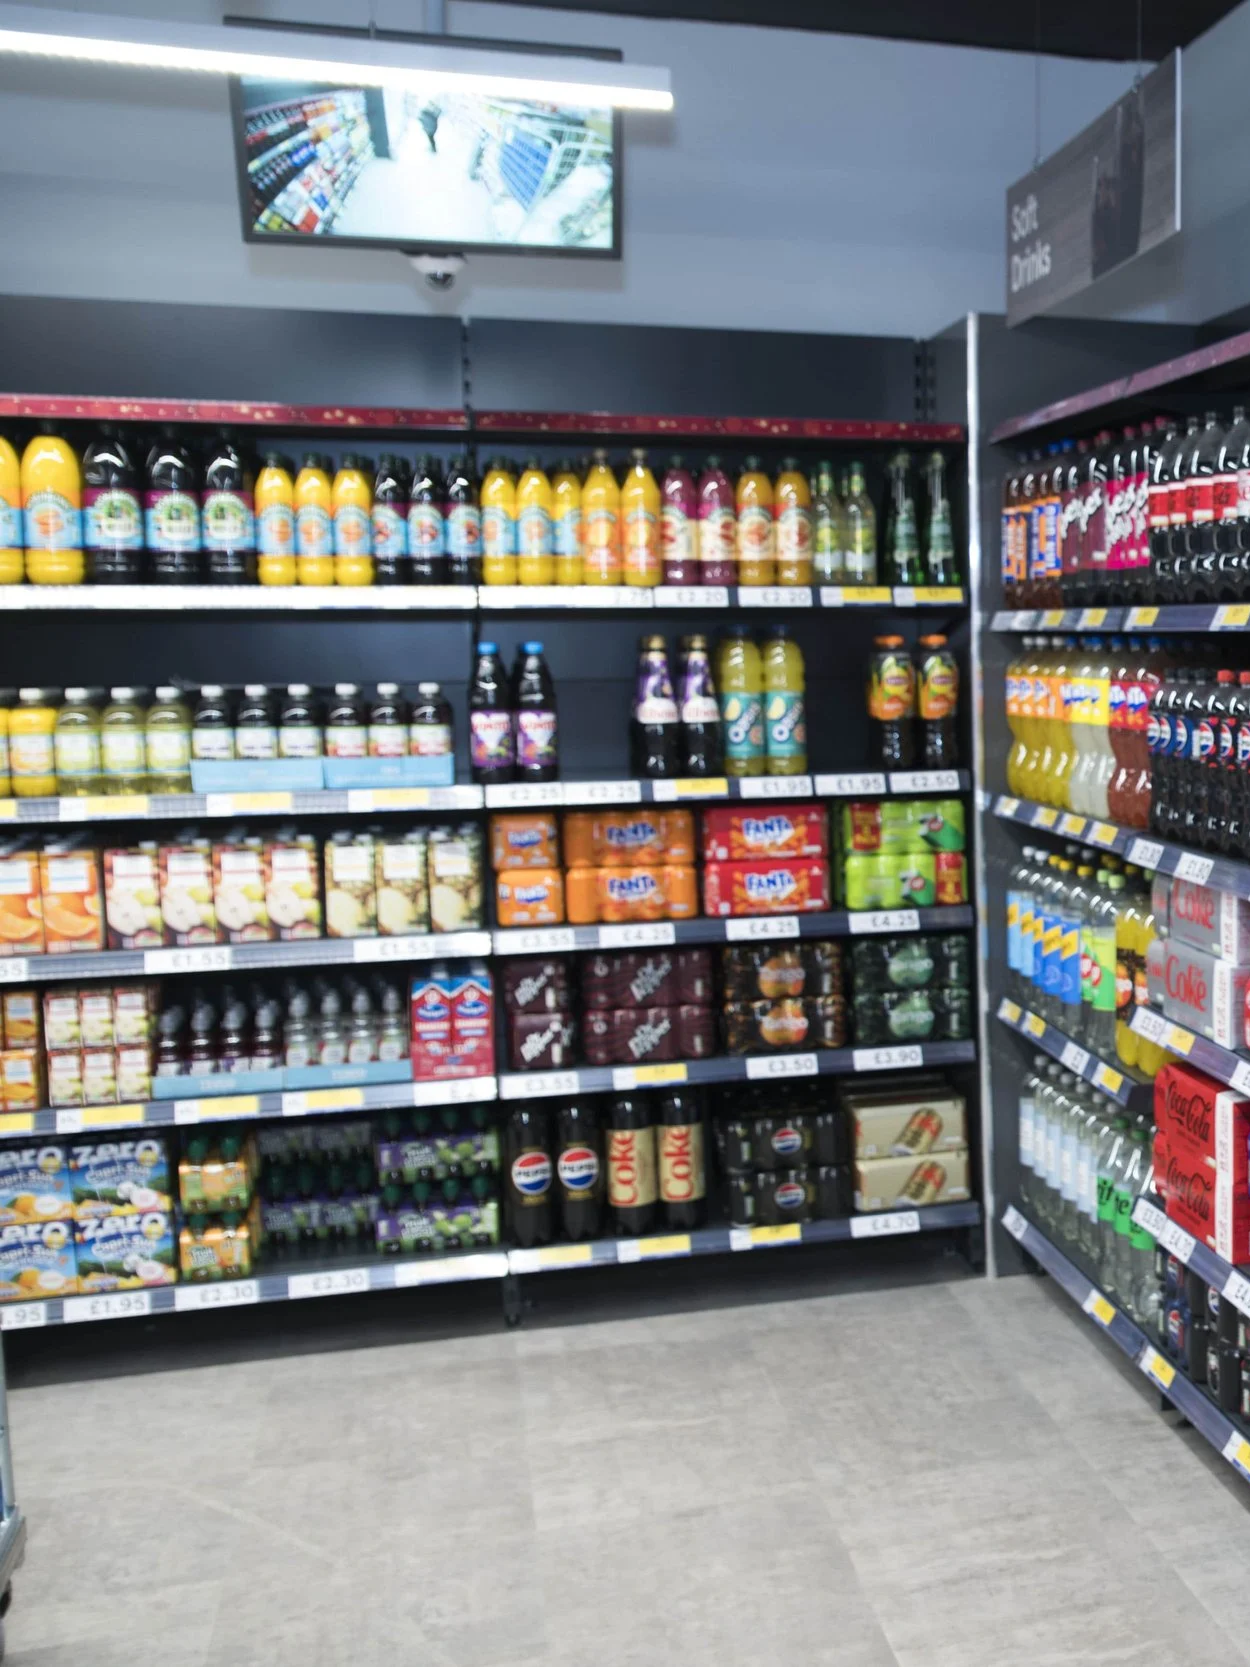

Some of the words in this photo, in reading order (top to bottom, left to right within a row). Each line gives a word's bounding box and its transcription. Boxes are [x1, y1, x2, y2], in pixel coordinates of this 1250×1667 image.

[1012, 194, 1038, 242] Soft
[1012, 239, 1051, 292] Drinks
[911, 774, 956, 788] £2.50
[744, 871, 797, 896] FANTA
[870, 914, 915, 929] £4.25
[768, 1059, 815, 1073] £3.50
[873, 1051, 919, 1065] £3.90
[90, 1297, 145, 1316] £1.95
